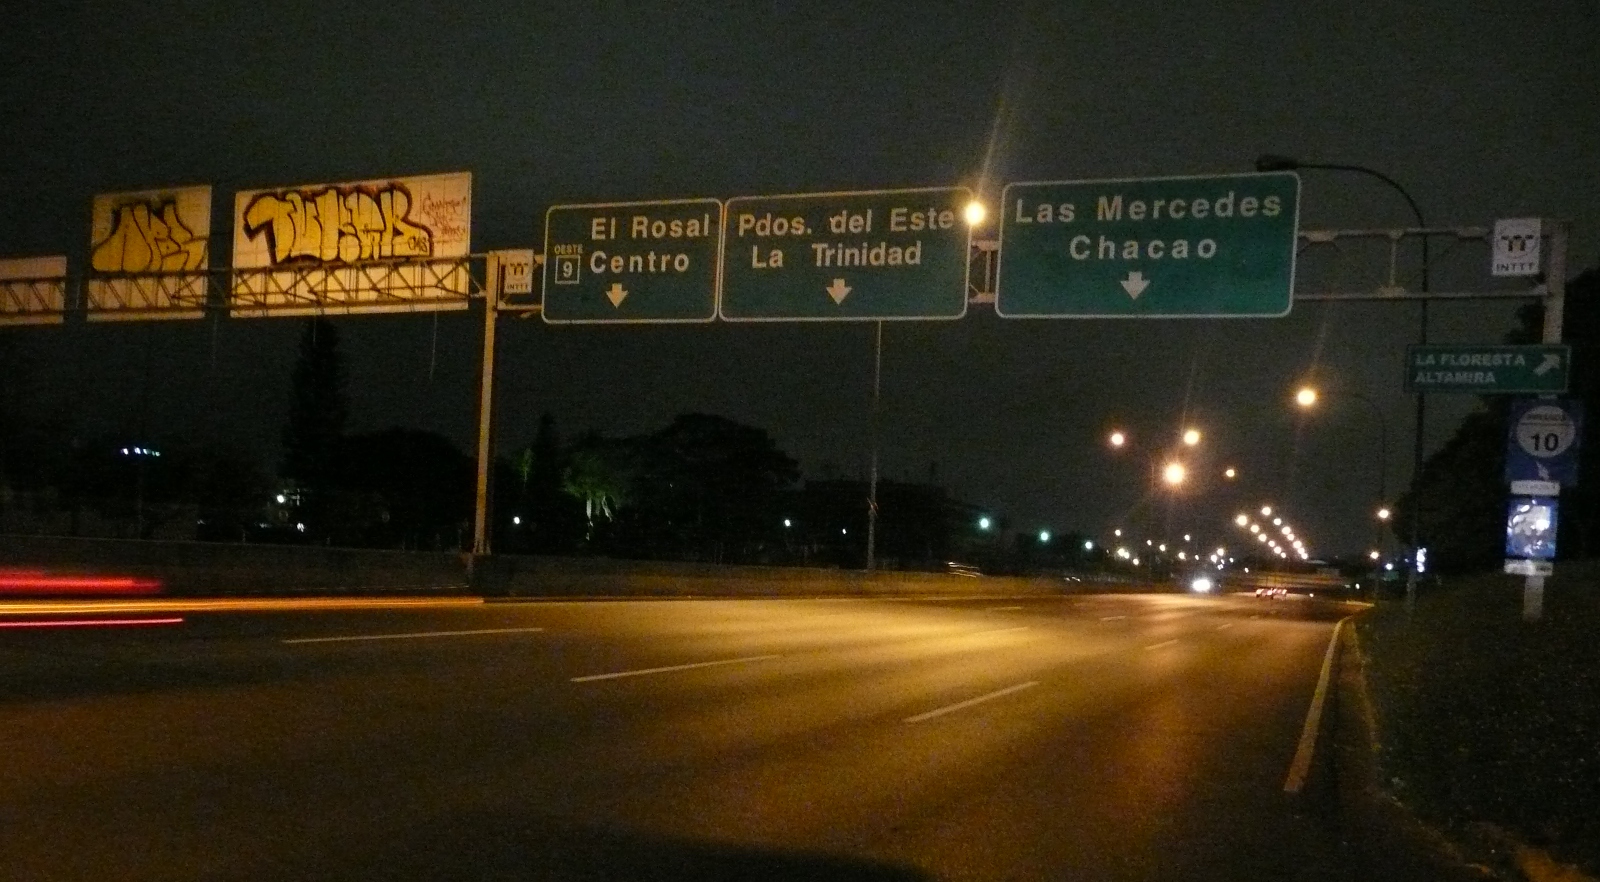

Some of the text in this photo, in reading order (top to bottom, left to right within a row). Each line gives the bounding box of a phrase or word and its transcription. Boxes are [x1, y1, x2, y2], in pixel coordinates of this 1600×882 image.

[1015, 191, 1282, 223] Las Mercedes
[590, 212, 710, 240] El Rosal
[738, 206, 955, 237] Pdos. del Este
[554, 243, 583, 255] OESTE
[751, 240, 922, 268] La Trinidad
[1069, 235, 1217, 260] Chacao
[562, 261, 573, 278] 9
[589, 250, 690, 274] Centro
[1496, 262, 1534, 272] INTTT
[1415, 353, 1526, 367] LA FLORESTA
[1414, 372, 1496, 384] ALTAMIRA
[1531, 433, 1559, 451] 10
